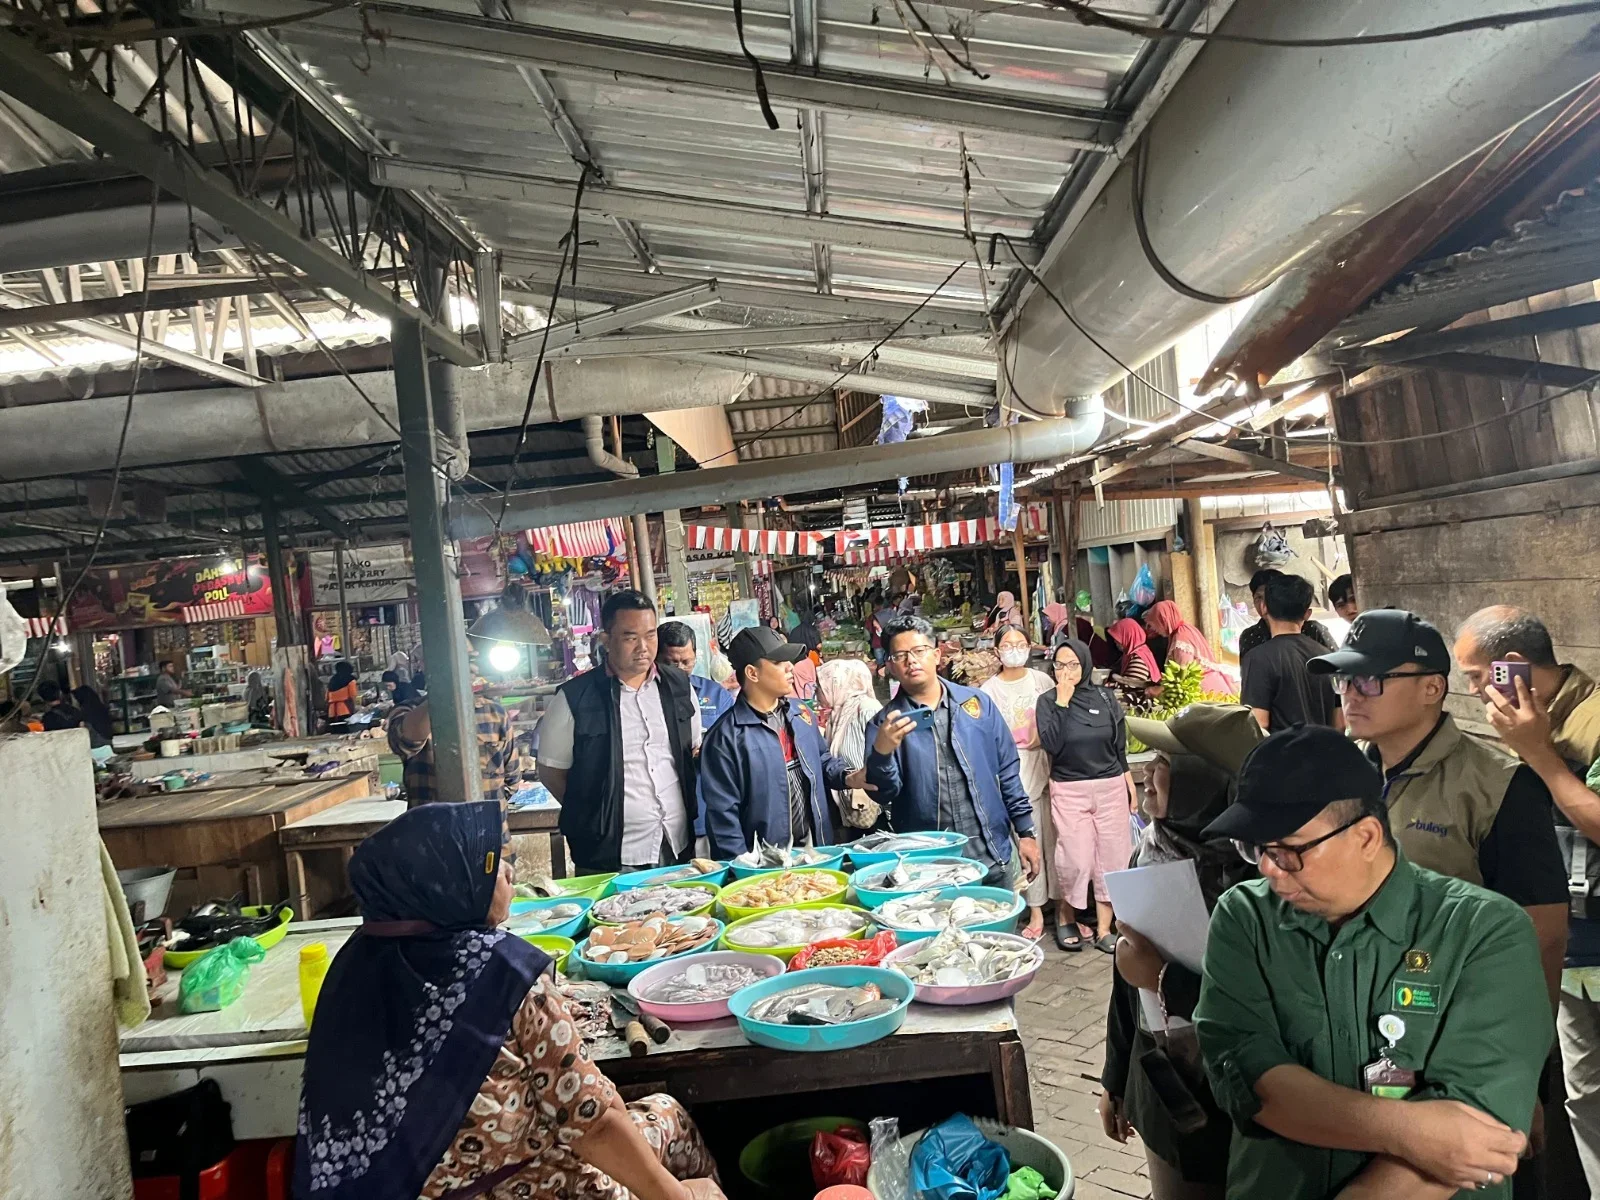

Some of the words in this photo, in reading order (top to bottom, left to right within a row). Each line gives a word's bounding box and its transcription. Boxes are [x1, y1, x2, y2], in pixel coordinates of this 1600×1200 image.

[686, 551, 714, 561] ASAR
[204, 587, 230, 603] POLL
[1415, 817, 1448, 837] bulog
